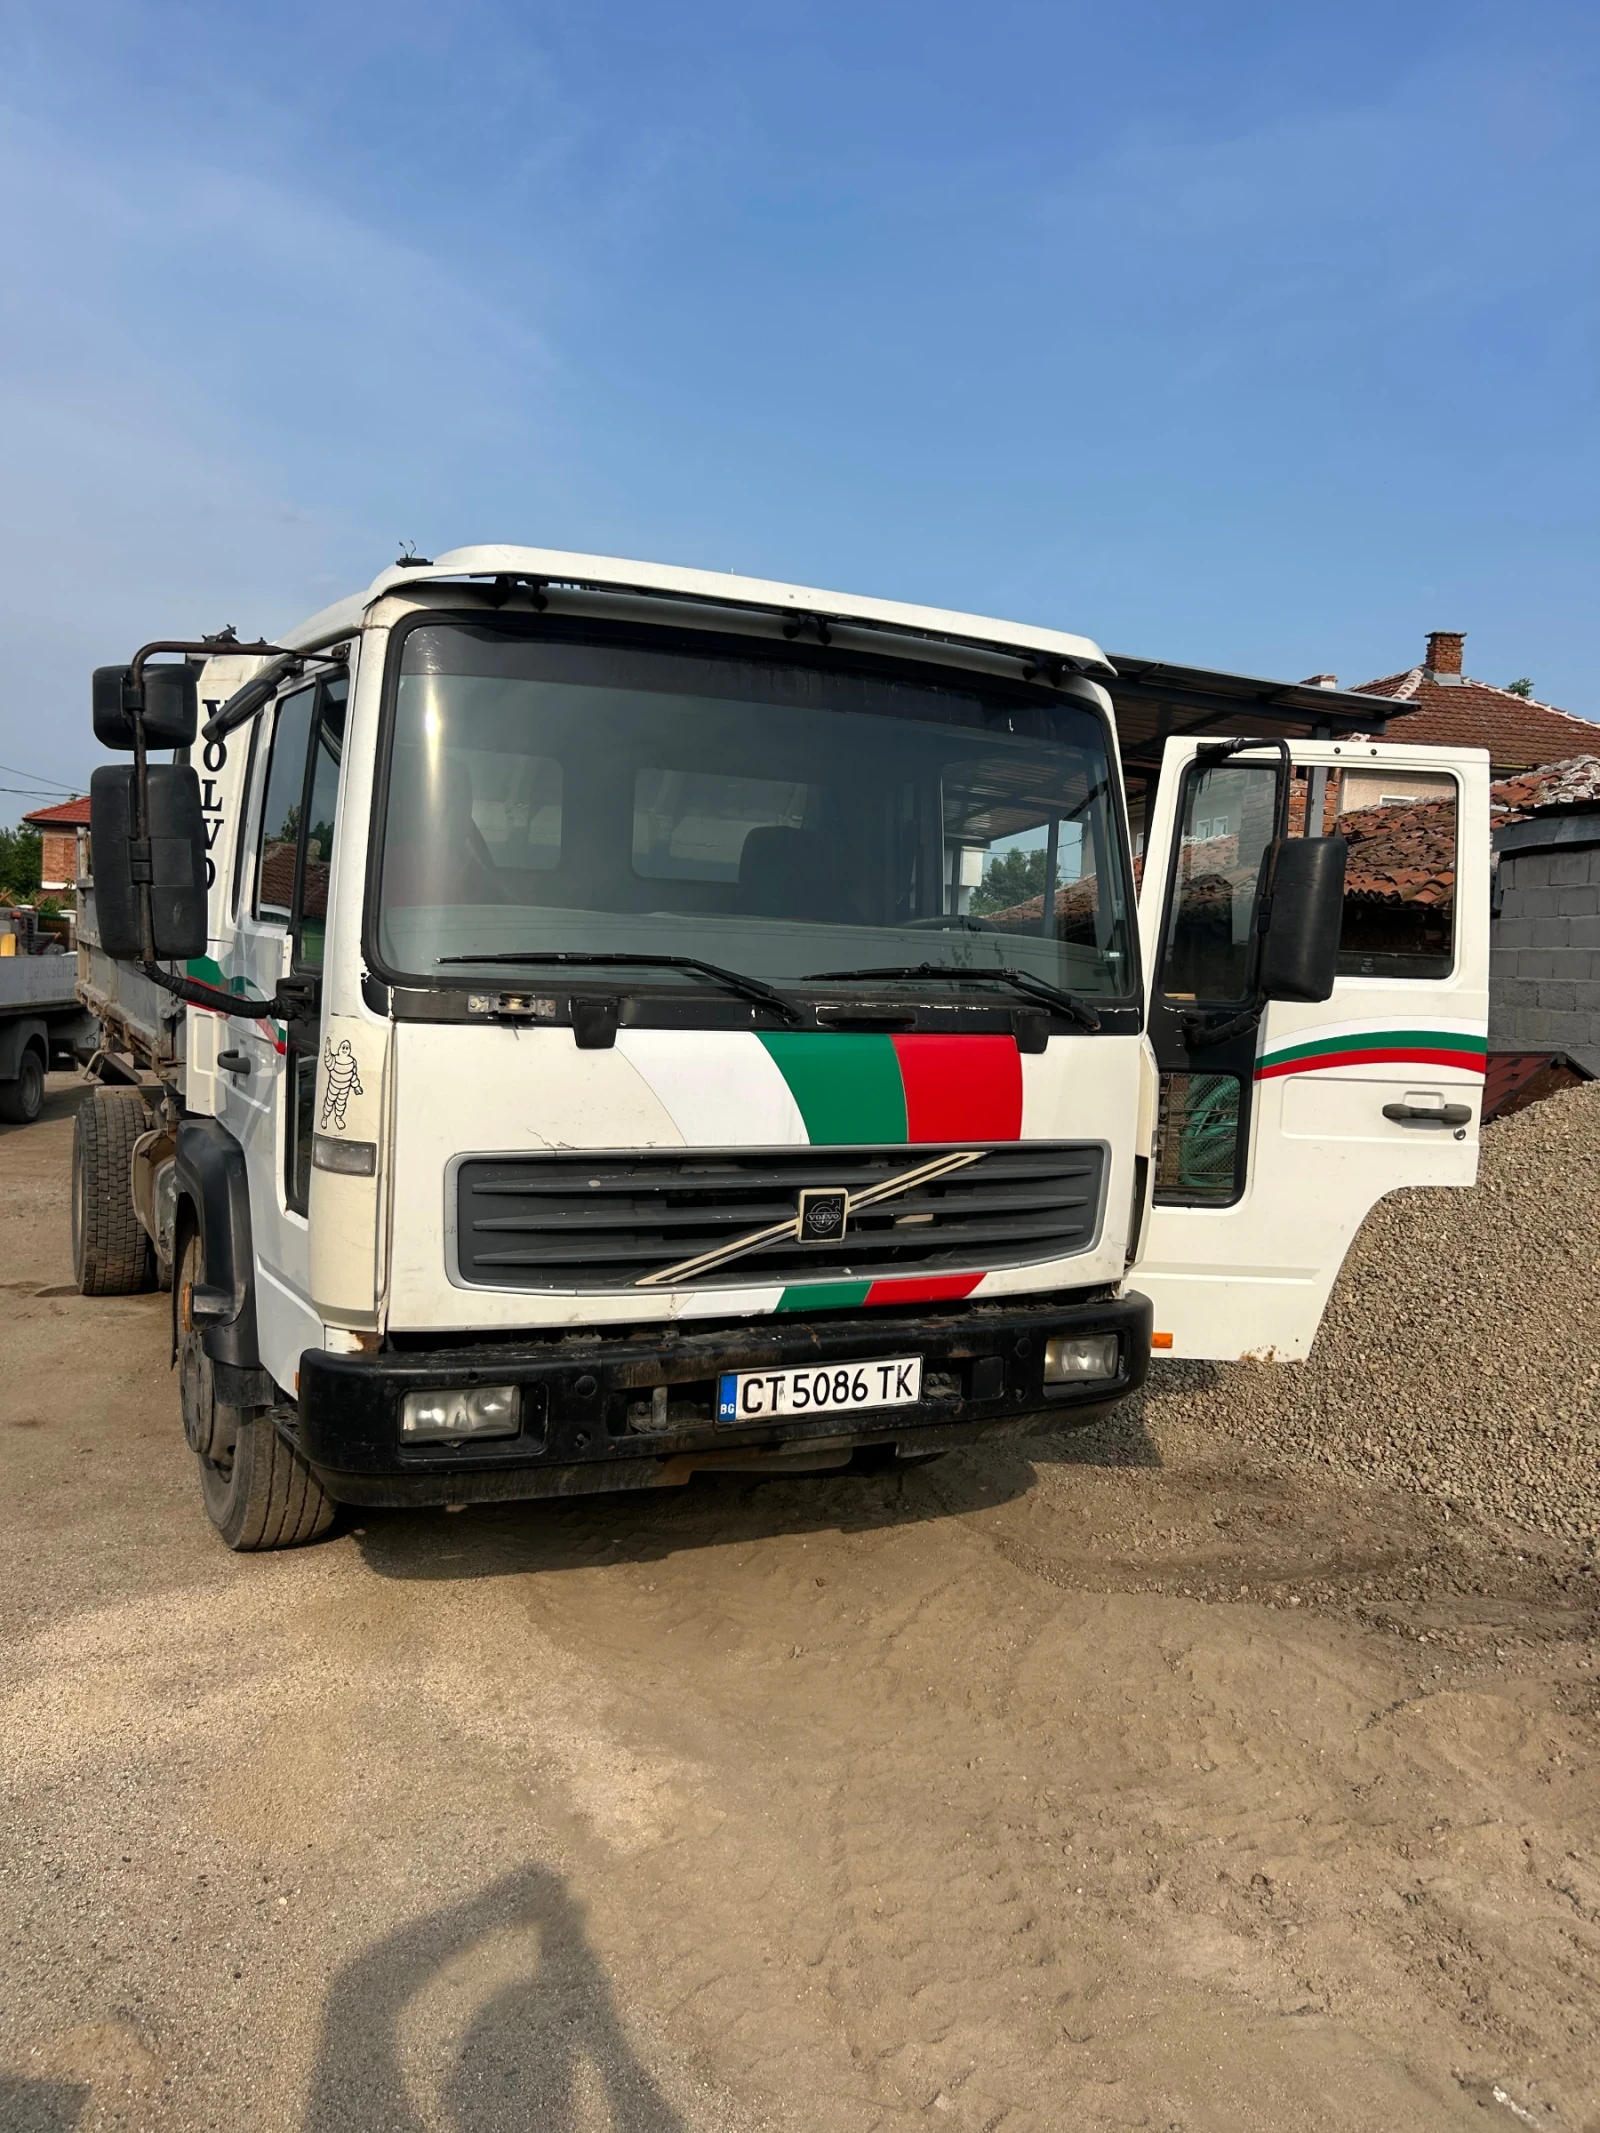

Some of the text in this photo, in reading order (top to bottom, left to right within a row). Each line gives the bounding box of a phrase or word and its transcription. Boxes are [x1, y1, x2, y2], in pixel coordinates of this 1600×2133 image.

[808, 1213, 839, 1222] VOLVO
[741, 1363, 914, 1414] CT 5086 TK
[720, 1403, 735, 1415] BG
